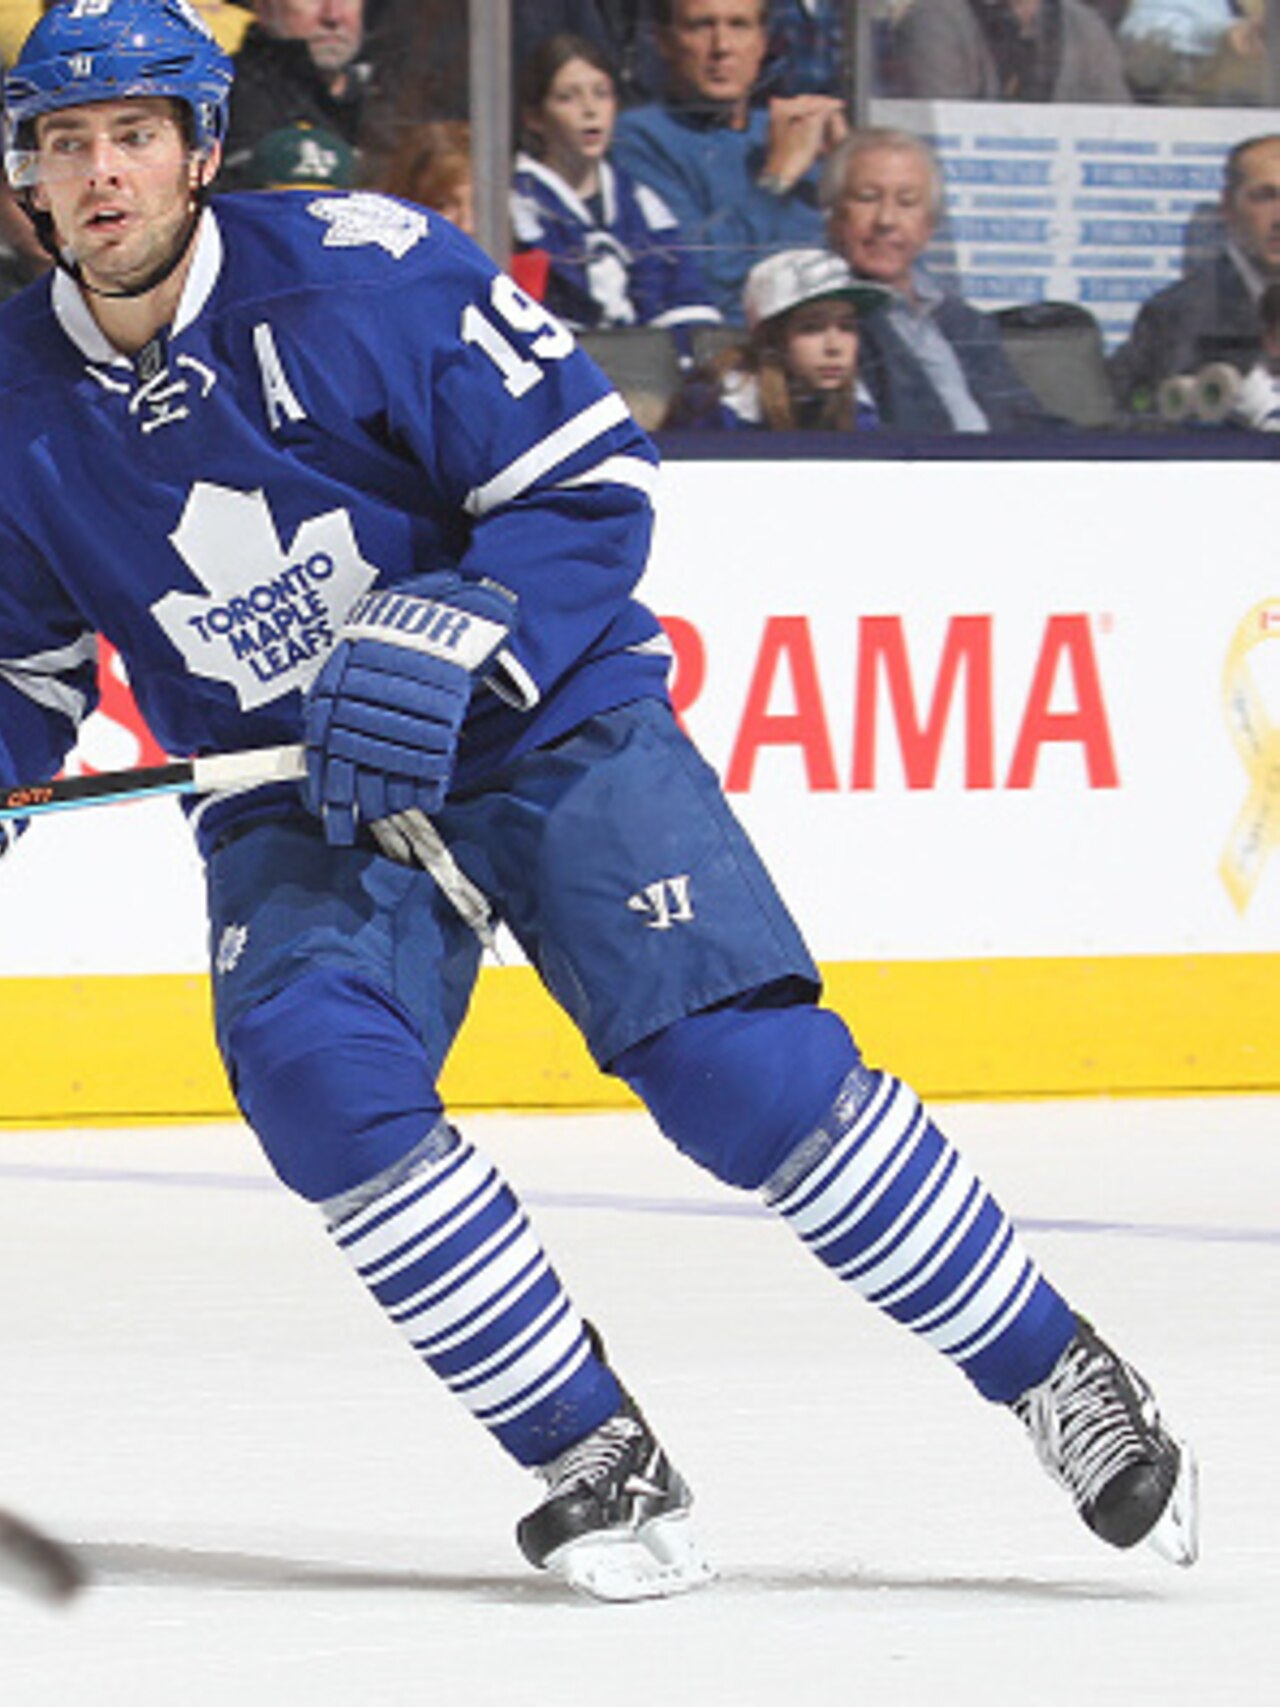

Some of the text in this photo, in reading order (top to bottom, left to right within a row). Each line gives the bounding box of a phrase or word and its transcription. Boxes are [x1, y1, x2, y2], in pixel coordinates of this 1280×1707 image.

[252, 321, 308, 432] A
[460, 271, 576, 398] 19
[187, 551, 334, 643] TORONTO
[227, 589, 329, 661] MAPLE
[248, 619, 334, 683] LEAFS
